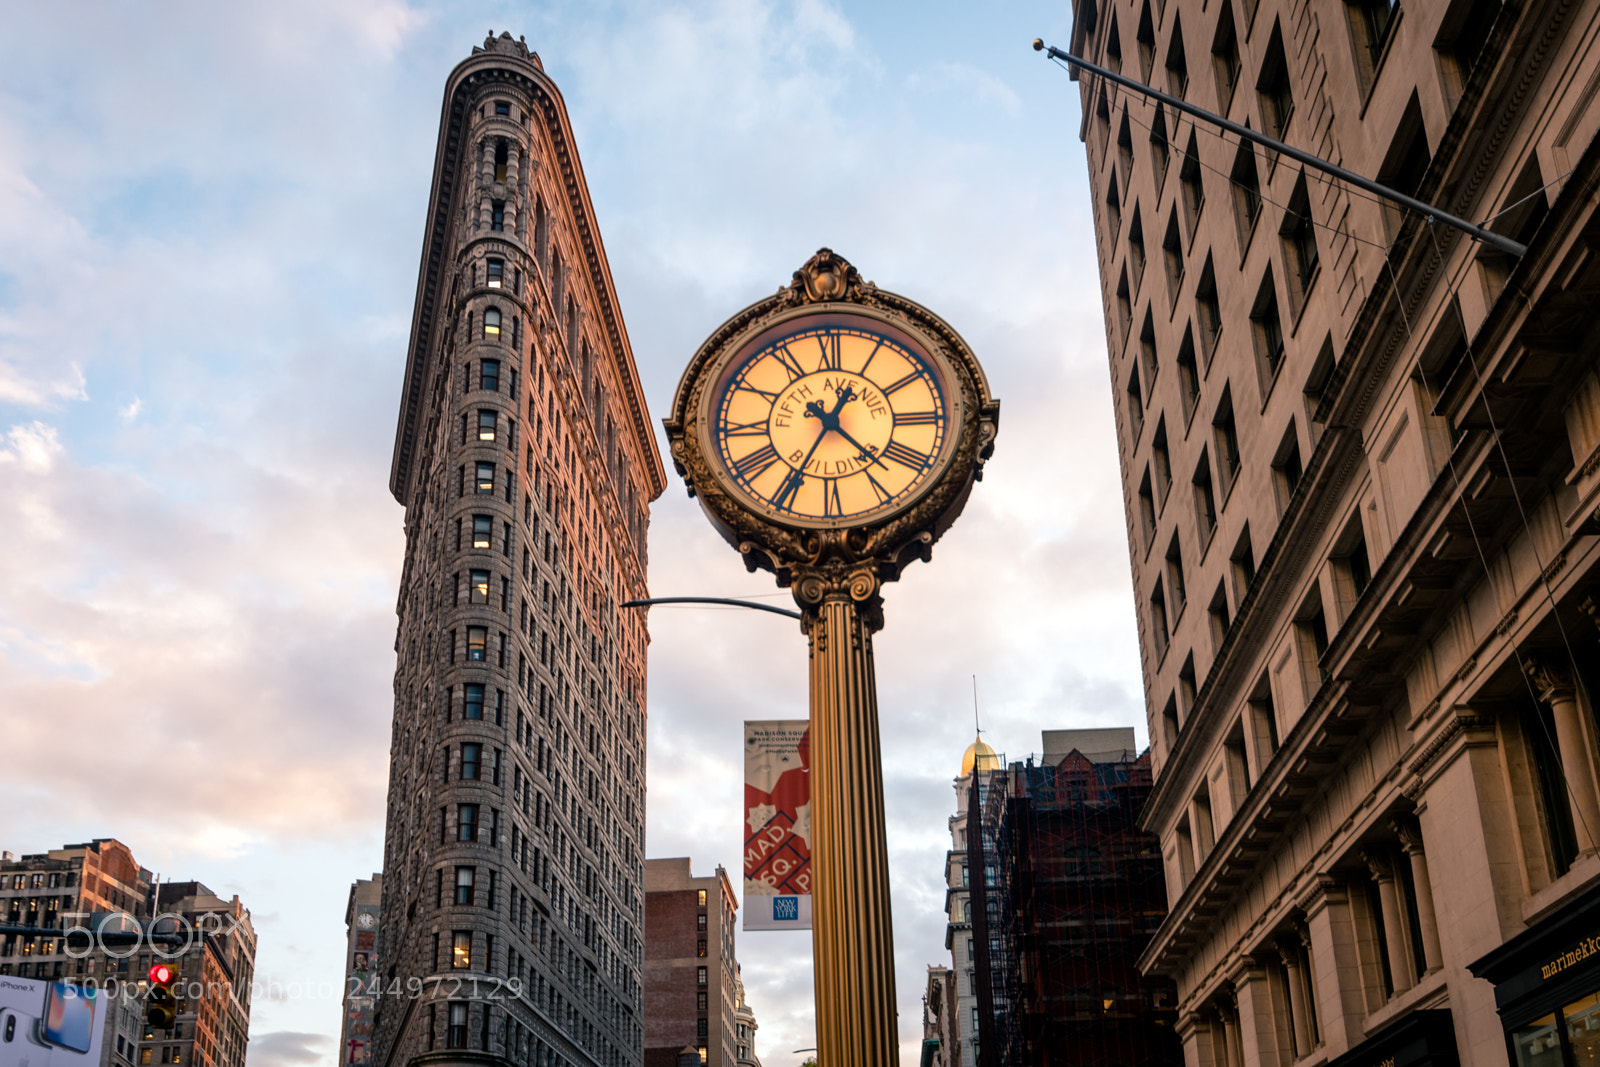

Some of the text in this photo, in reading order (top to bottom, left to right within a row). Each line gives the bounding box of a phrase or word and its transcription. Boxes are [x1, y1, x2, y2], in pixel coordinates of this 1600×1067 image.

[775, 377, 887, 427] FIFTH AVENUE
[788, 443, 879, 475] BUILDING
[760, 858, 797, 886] SQ.
[775, 904, 797, 912] YORK
[777, 910, 795, 918] LIFE
[1541, 936, 1600, 980] marimekko
[0, 981, 36, 993] iPhone X
